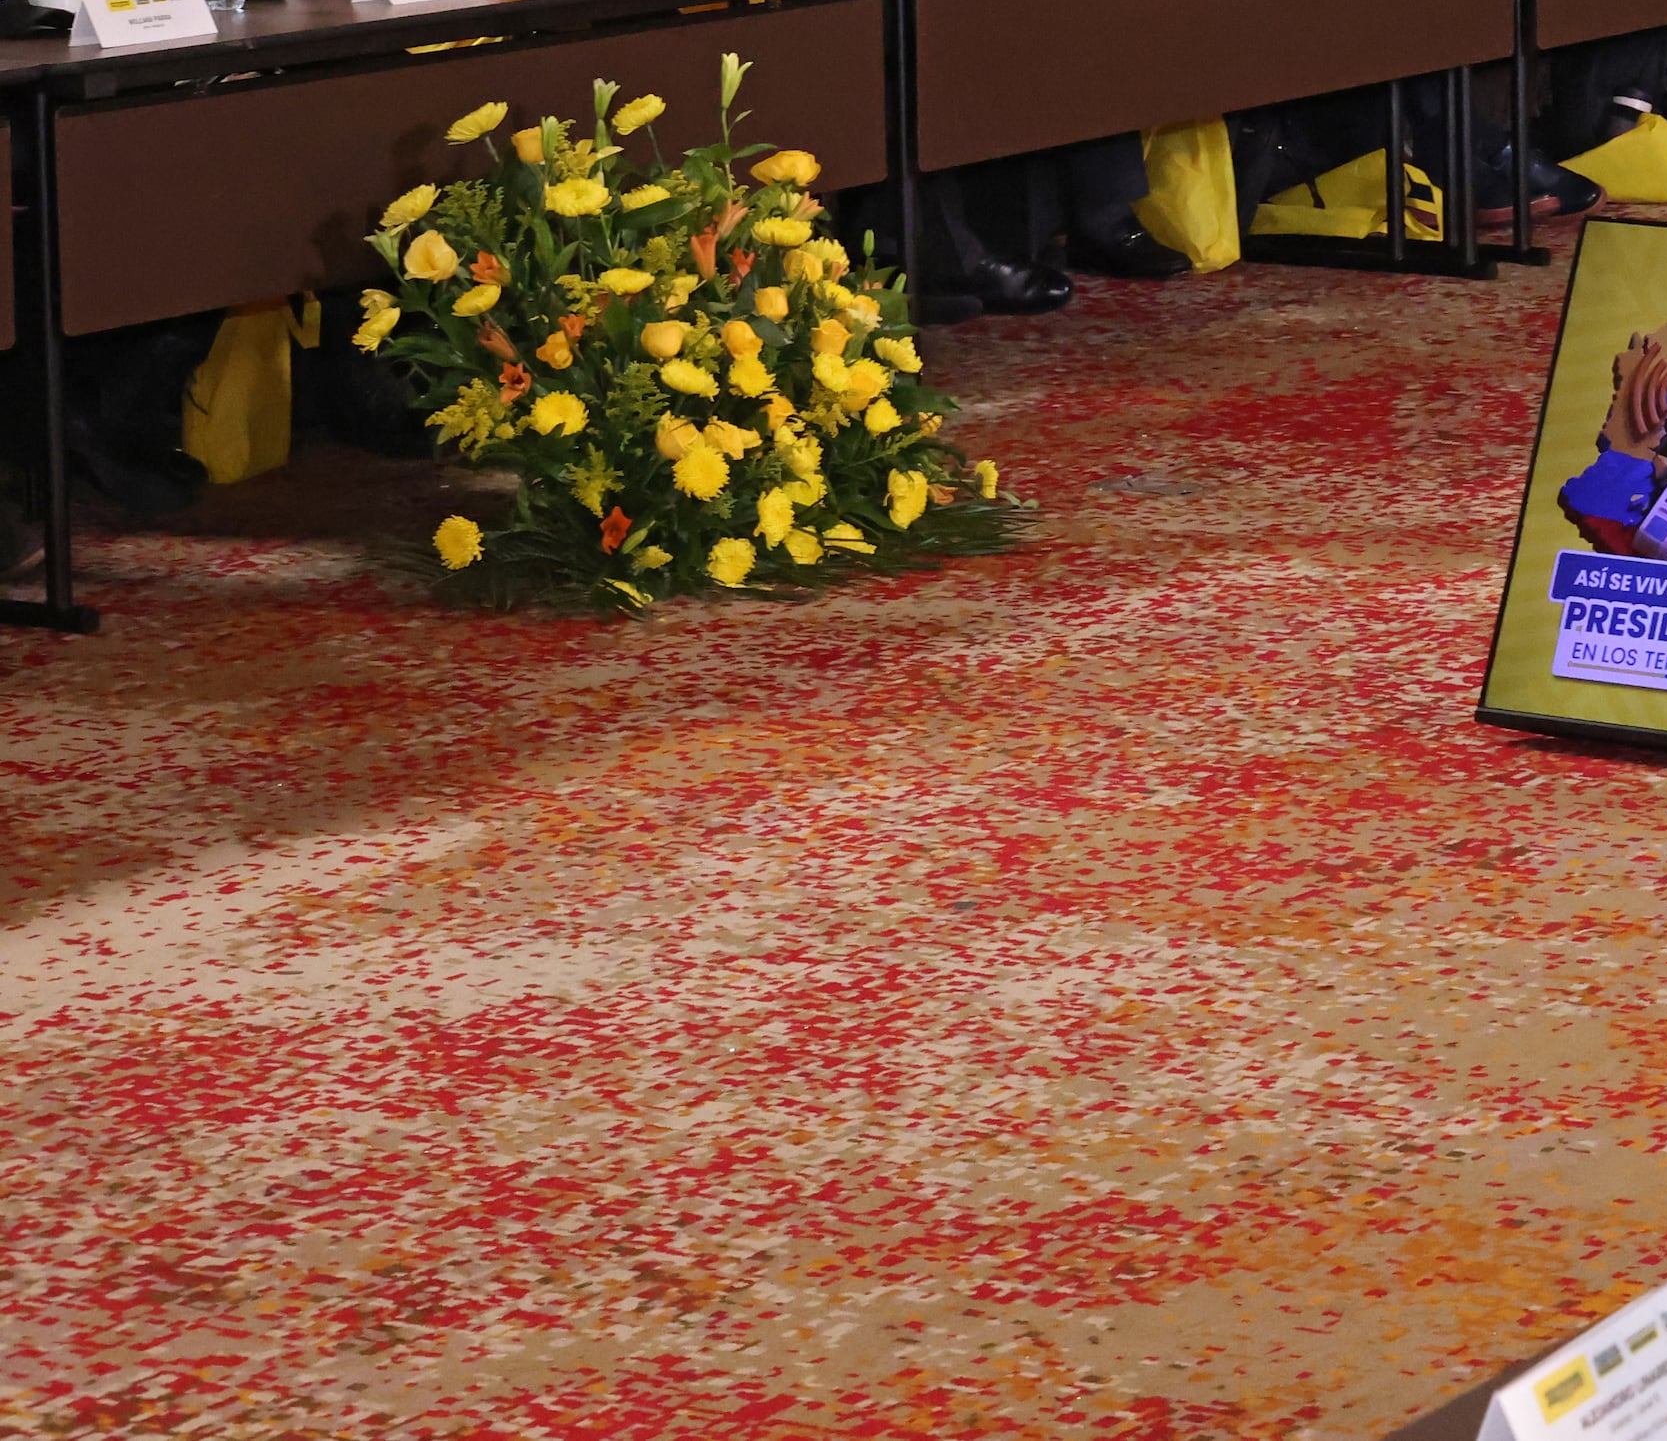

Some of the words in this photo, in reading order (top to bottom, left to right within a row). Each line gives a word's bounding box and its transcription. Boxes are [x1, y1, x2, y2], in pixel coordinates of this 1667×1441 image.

[1574, 567, 1608, 588] ASÍ
[1609, 573, 1632, 592] SE
[1572, 642, 1597, 661] EN
[1602, 645, 1637, 666] LOS
